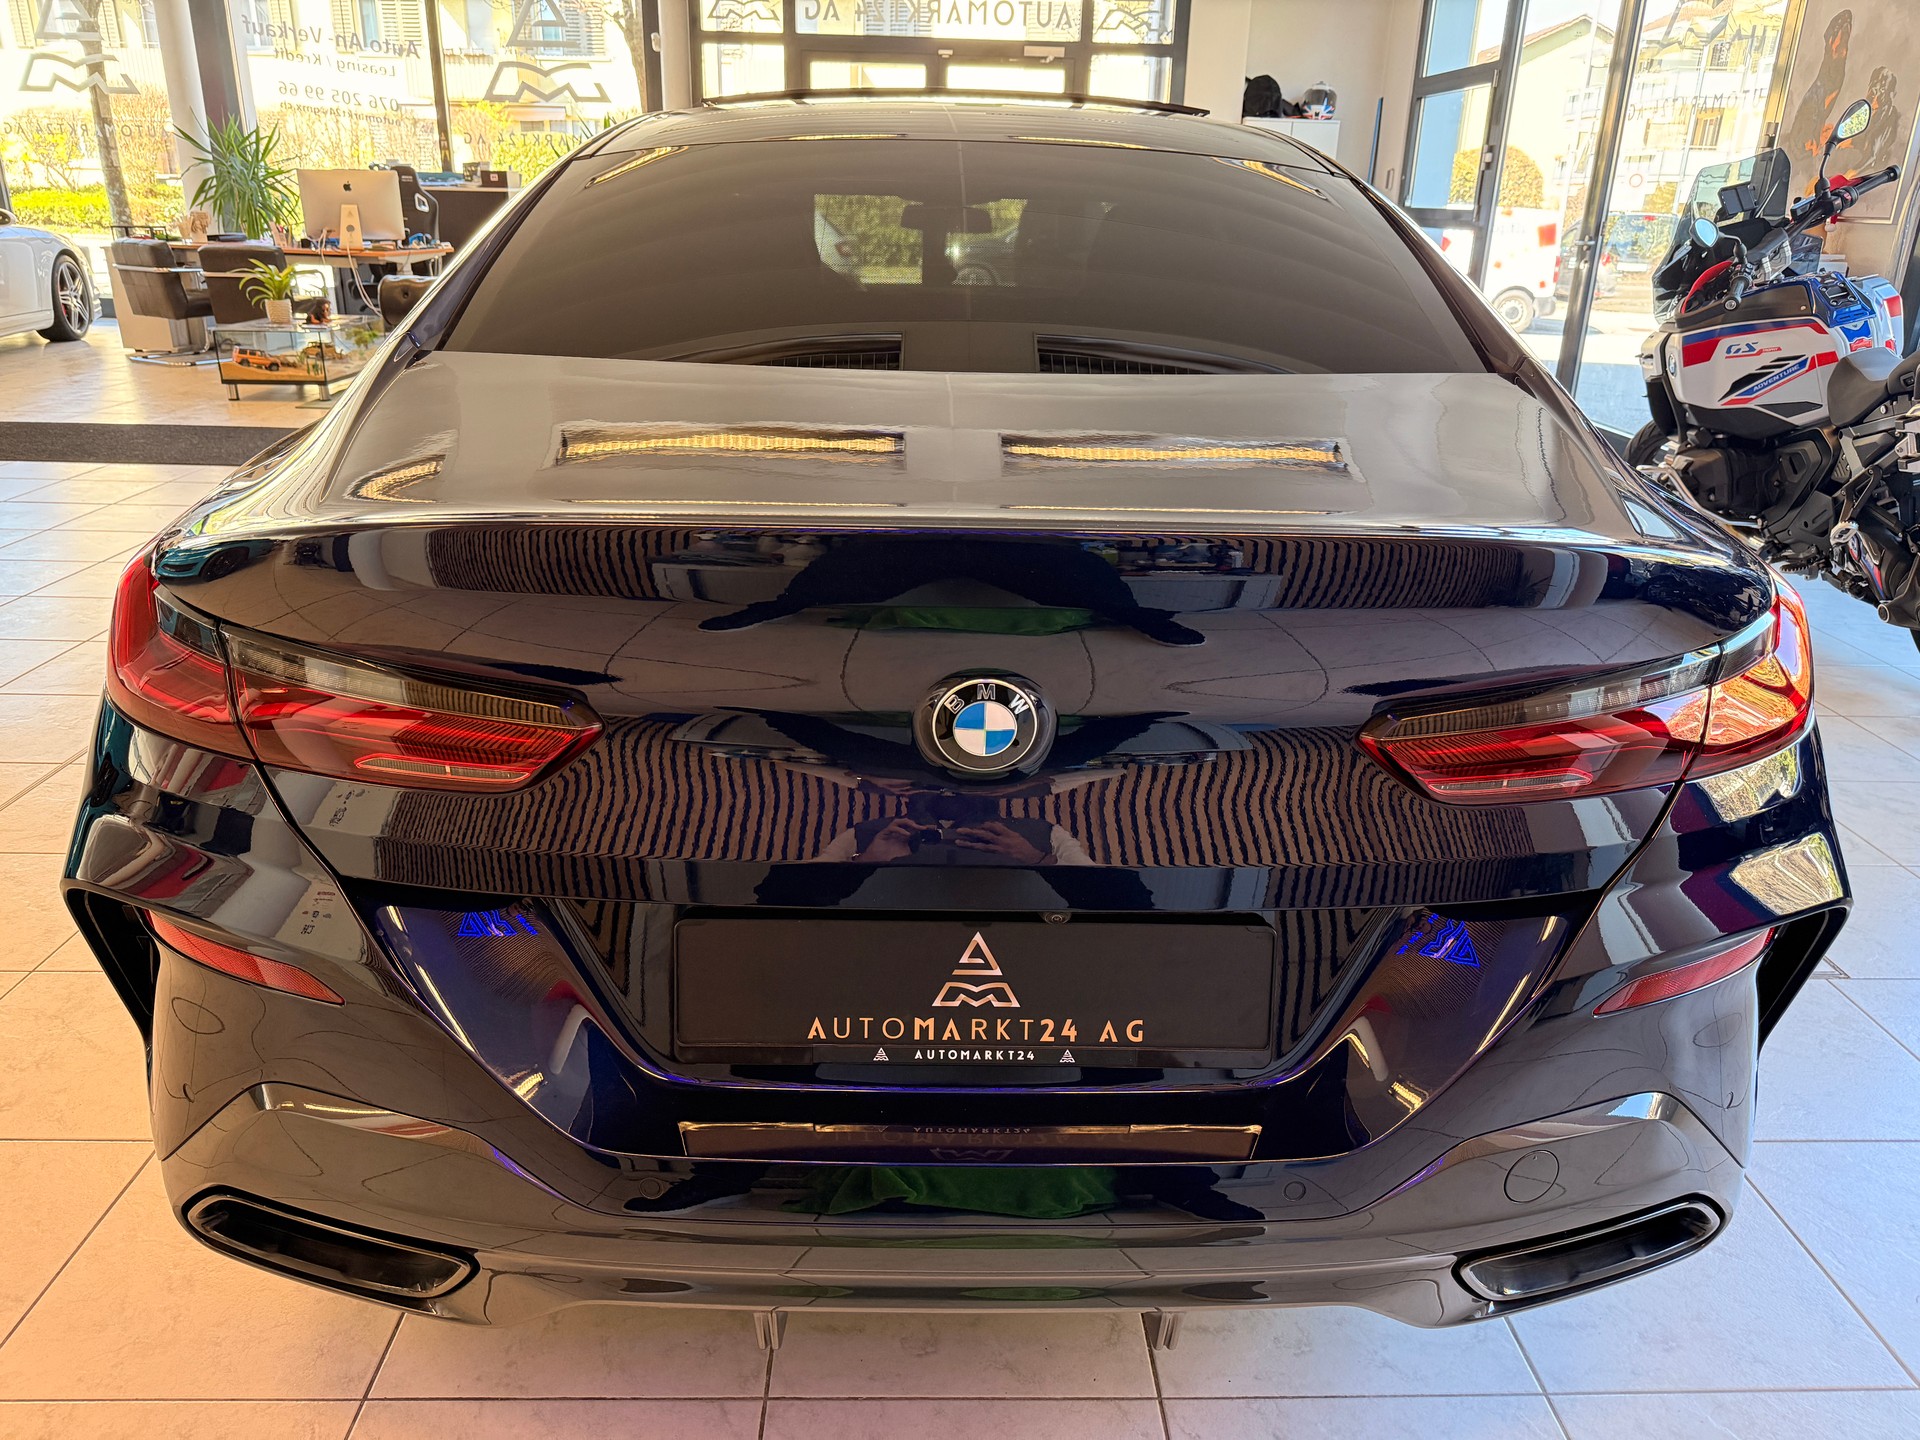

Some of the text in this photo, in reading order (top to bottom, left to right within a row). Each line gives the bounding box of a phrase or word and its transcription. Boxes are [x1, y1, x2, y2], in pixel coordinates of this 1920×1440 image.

[1725, 341, 1759, 355] GS
[1752, 364, 1800, 392] ADVENTURE
[944, 683, 1029, 715] BMW
[807, 1016, 1144, 1042] AUTOMARKT24 AG
[914, 1049, 1035, 1061] AUTOMARKT24
